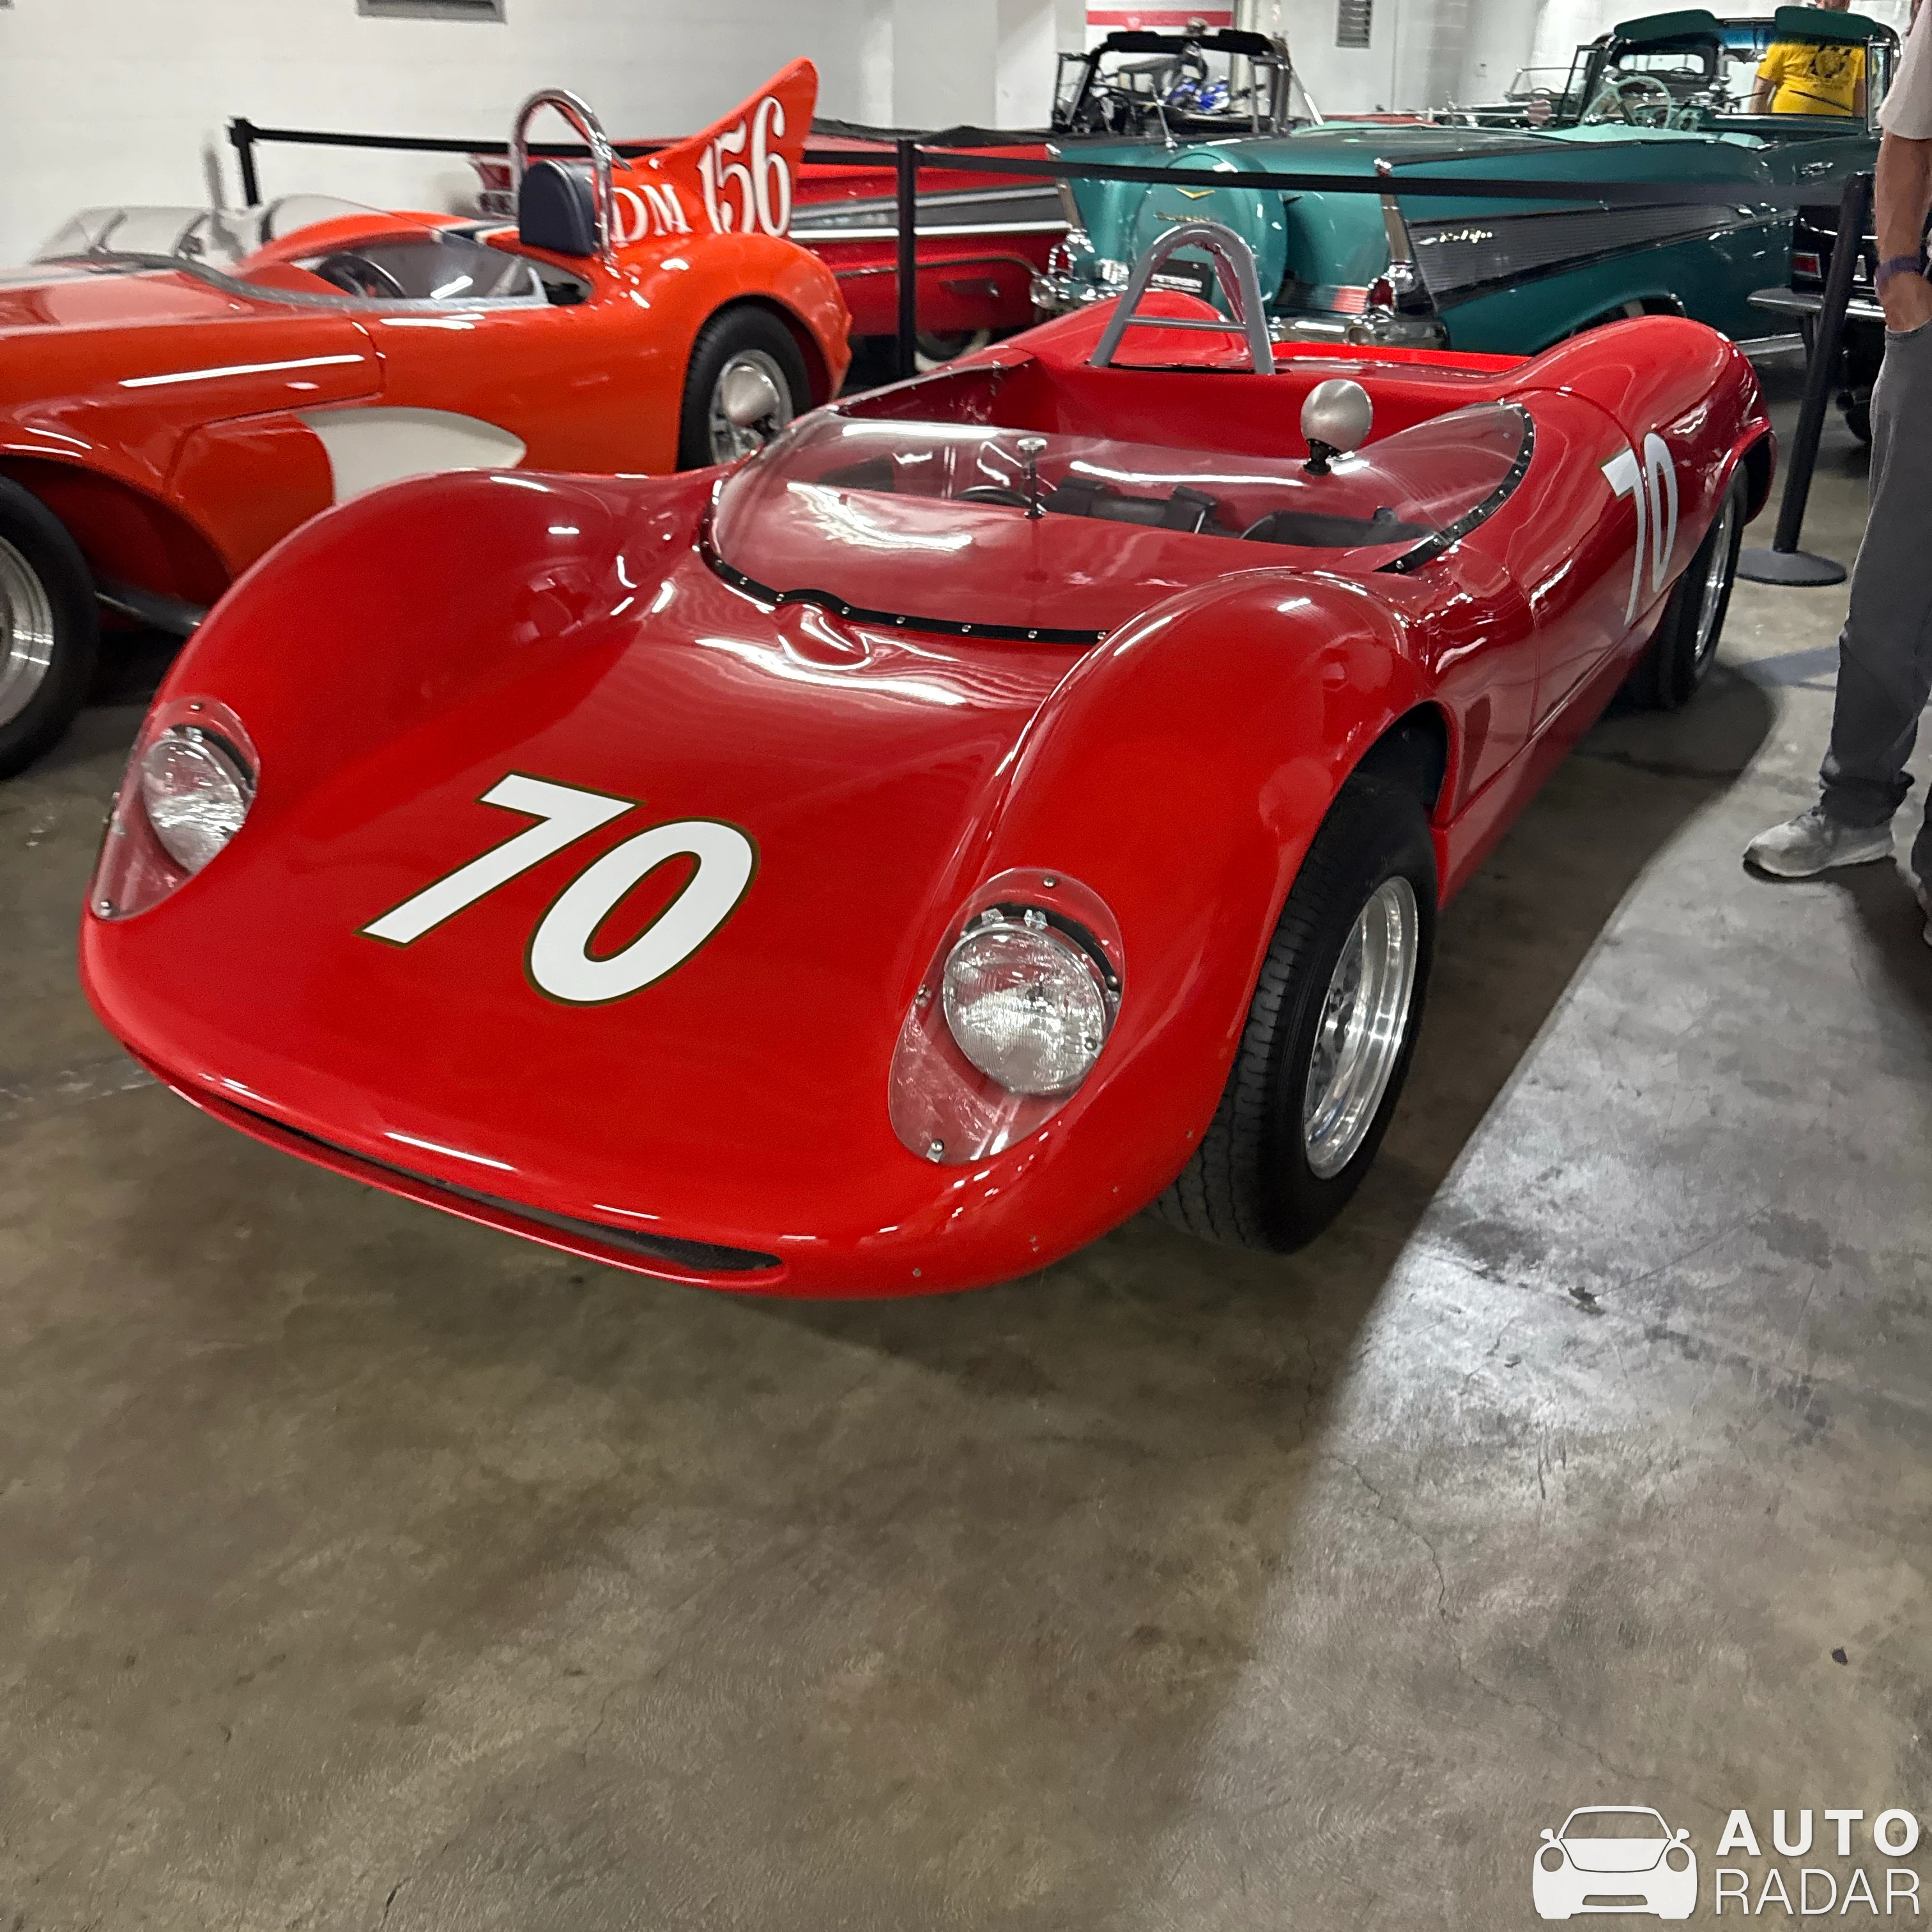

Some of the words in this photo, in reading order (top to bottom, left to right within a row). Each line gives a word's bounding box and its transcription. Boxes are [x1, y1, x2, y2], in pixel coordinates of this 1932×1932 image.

[610, 183, 693, 243] DM
[696, 96, 791, 237] 156
[1598, 431, 1678, 626] 70
[353, 770, 760, 1006] 70
